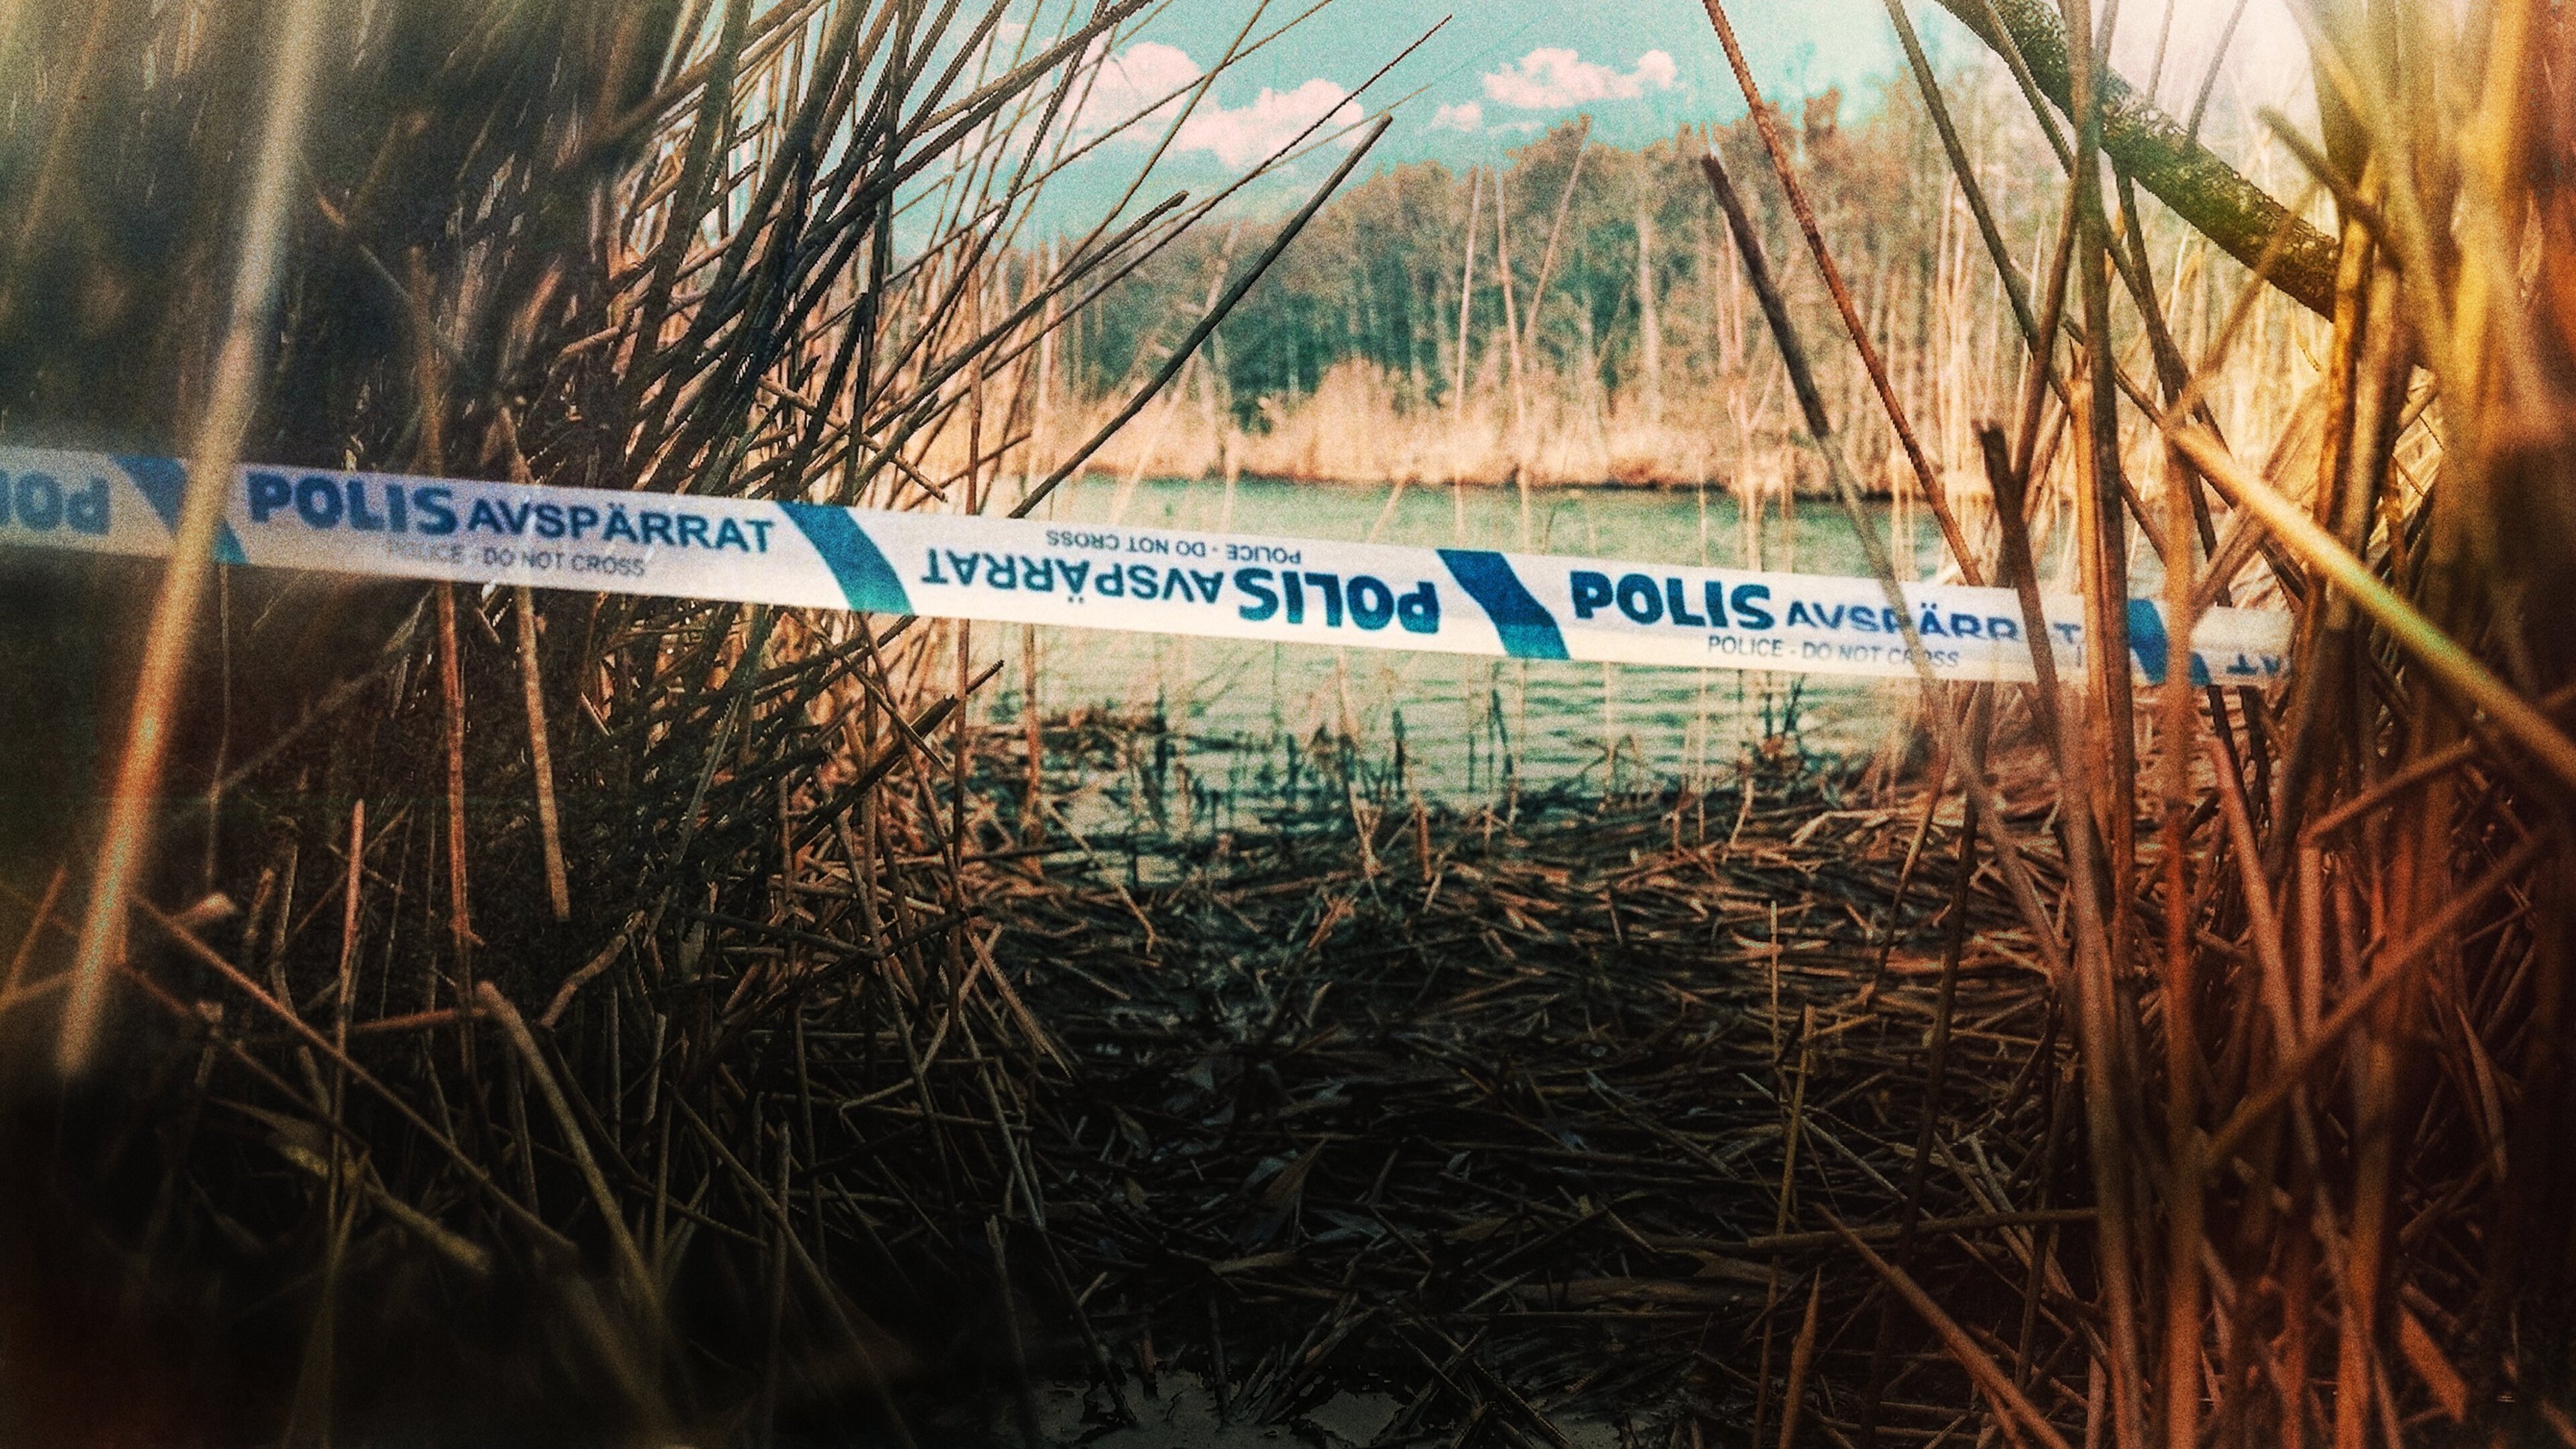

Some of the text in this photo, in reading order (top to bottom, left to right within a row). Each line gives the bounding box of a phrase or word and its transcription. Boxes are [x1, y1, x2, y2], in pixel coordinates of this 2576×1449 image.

[248, 473, 774, 553] POLIS AVSPÄRRAT
[1046, 529, 1120, 550] CROSS
[1127, 536, 1169, 555] NOT
[1176, 541, 1206, 558] DO
[483, 547, 515, 567] DO
[523, 551, 564, 570] NOT
[571, 554, 645, 577] CROSS
[1227, 544, 1301, 565] POLICE
[921, 548, 1439, 634] POLIS AVSPÄRRAT
[1570, 570, 2081, 645] POLIS AVSPÄRRT
[1708, 636, 1783, 658] POLICE
[1802, 641, 1832, 659] DO
[1839, 645, 1881, 663] NOT
